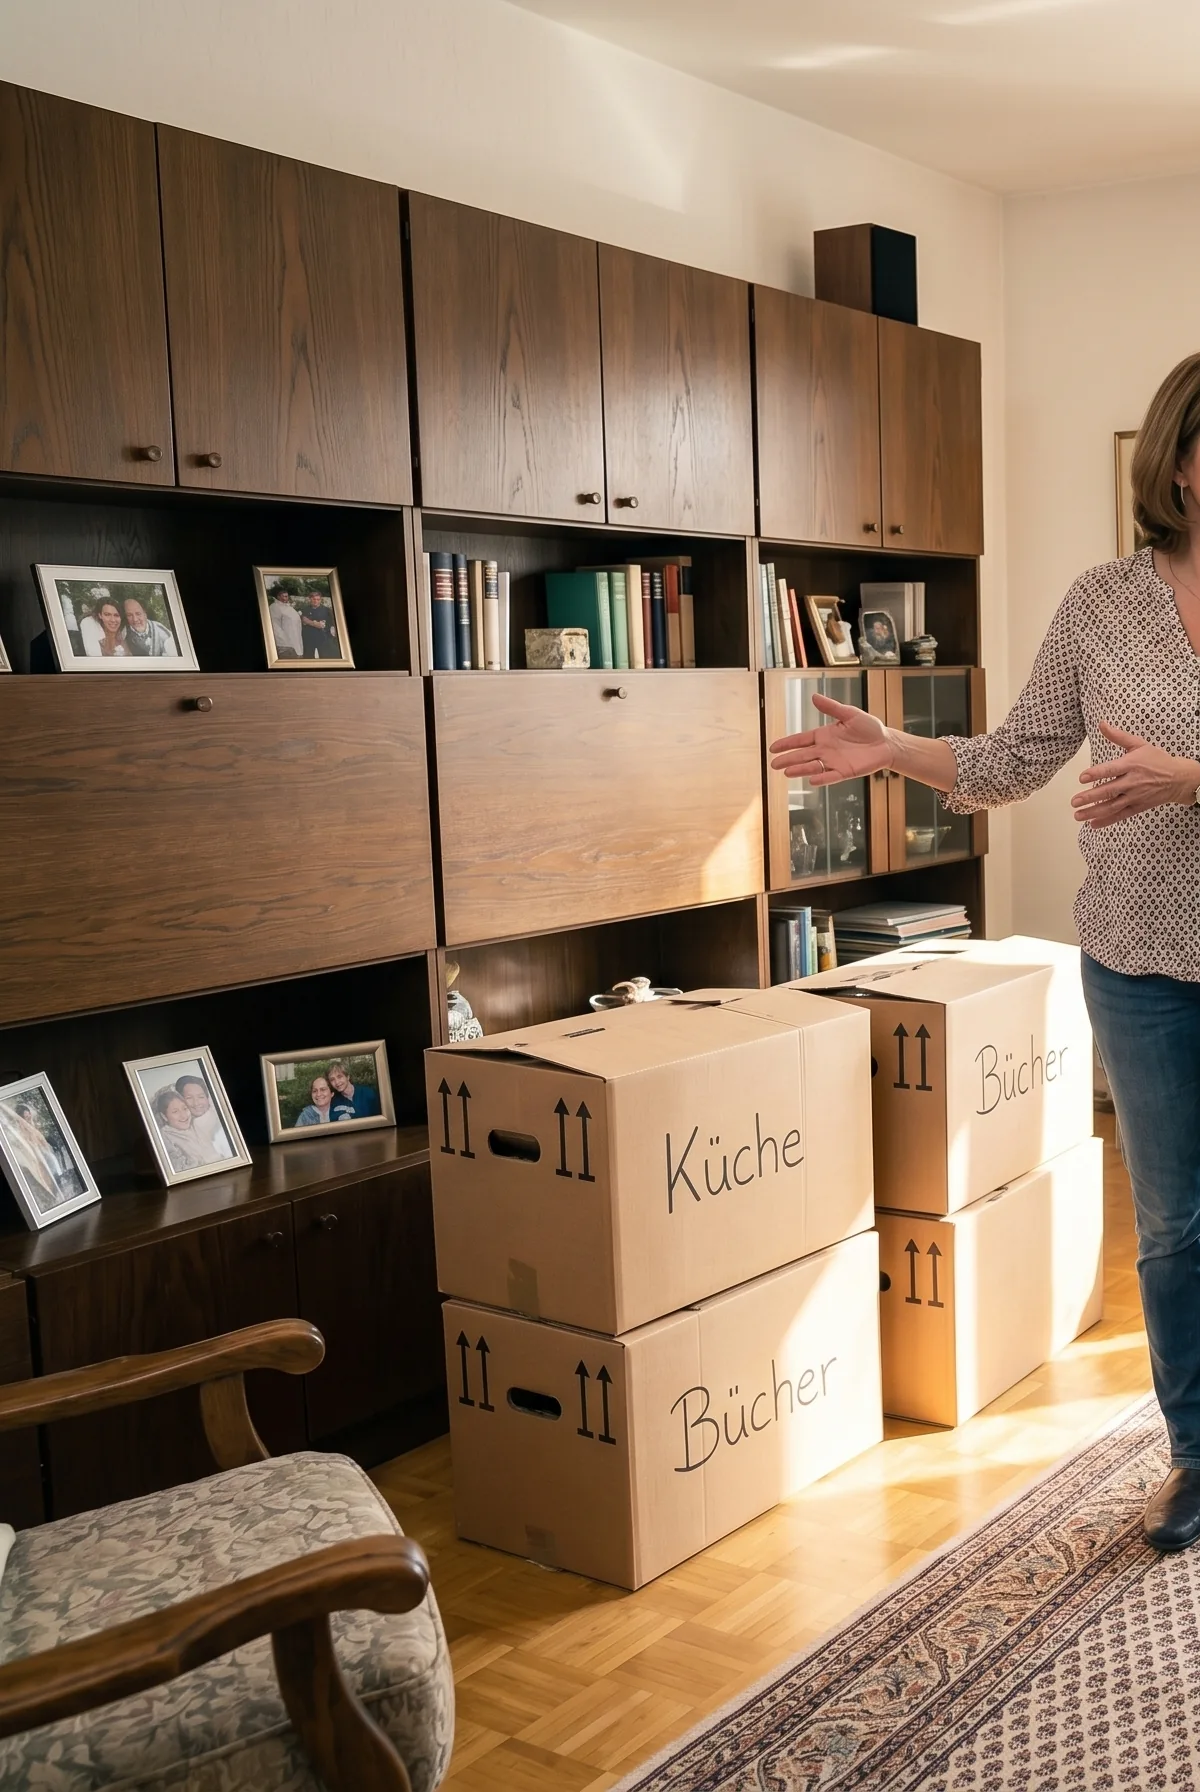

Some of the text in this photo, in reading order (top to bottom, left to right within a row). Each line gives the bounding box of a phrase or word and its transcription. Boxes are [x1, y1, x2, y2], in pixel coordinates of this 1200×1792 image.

[974, 1034, 1069, 1116] Bücher
[665, 1112, 805, 1215] Küche
[670, 1356, 838, 1473] Bücher
